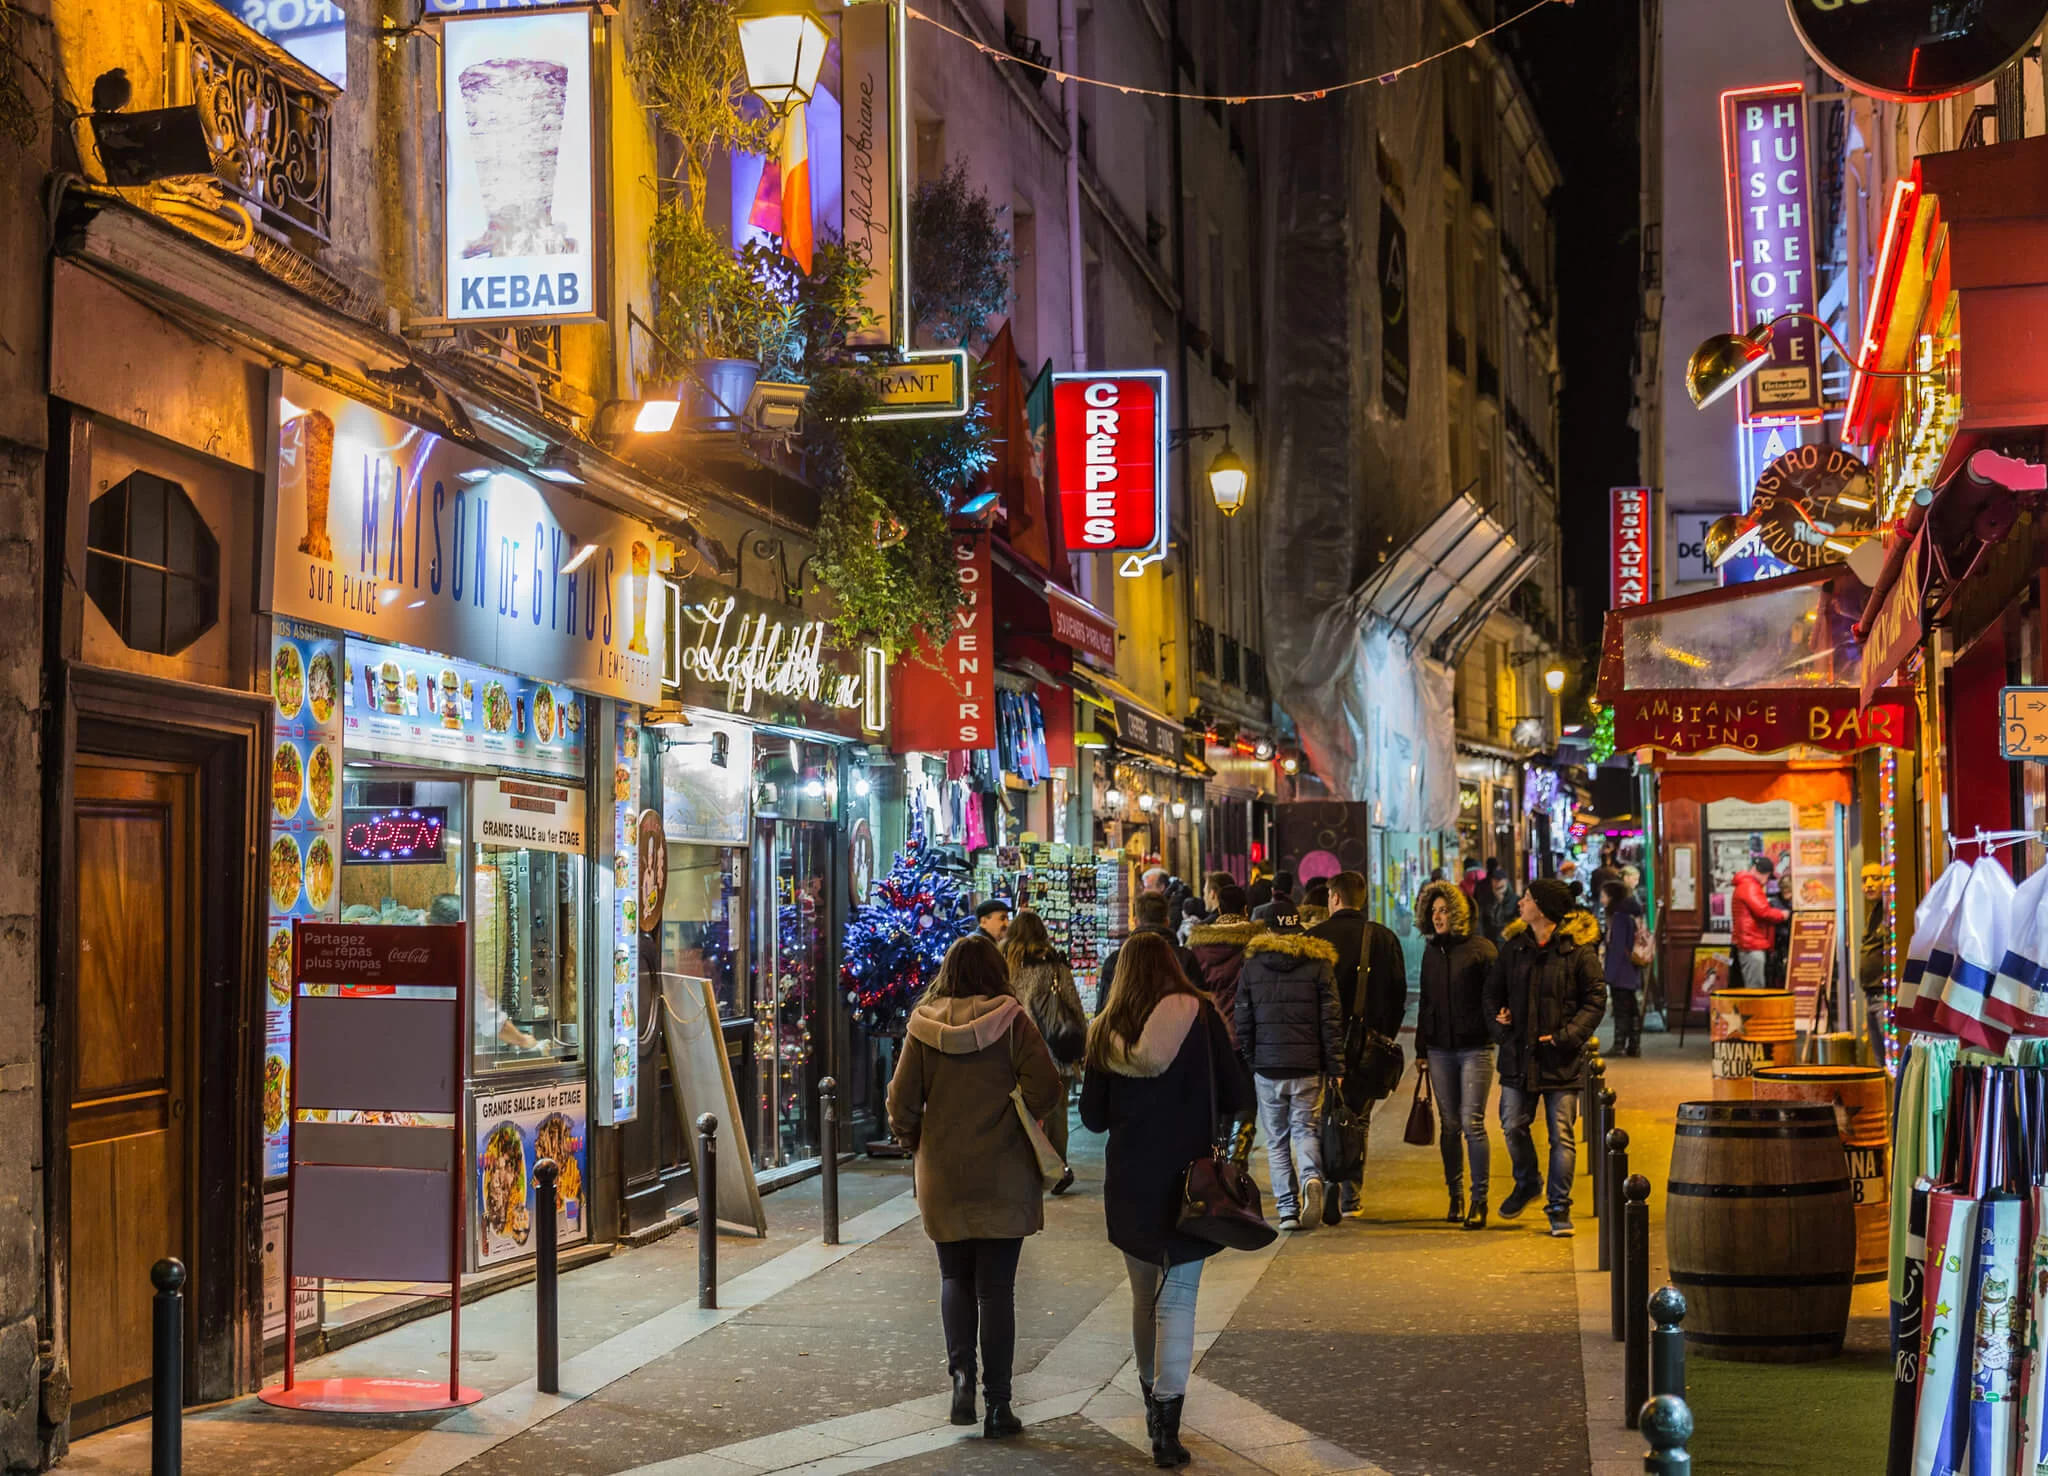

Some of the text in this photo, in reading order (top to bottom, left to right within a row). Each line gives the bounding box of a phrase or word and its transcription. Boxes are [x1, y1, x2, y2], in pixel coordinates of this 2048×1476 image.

[1746, 107, 1776, 297] BISTRO
[1773, 103, 1804, 361] HUCHETTE
[461, 272, 579, 310] KEBAB
[1756, 308, 1774, 325] DE
[1083, 382, 1119, 544] CRÊPES
[1753, 445, 1818, 510] BISTRO
[1828, 451, 1859, 480] DE
[1800, 496, 1831, 519] 27
[361, 454, 613, 645] MAISON DE GYROS
[1619, 490, 1643, 608] RESTAURAN
[309, 564, 377, 615] SUR PLACE
[1636, 700, 1777, 724] AMBIANCE
[2007, 694, 2024, 720] 1
[1655, 725, 1759, 749] LATINO
[1809, 706, 1892, 741] BAR
[2008, 724, 2031, 753] 2
[347, 822, 440, 851] OPEN
[483, 821, 580, 846] GRANDE SALLE au 1er ETAGE
[304, 932, 366, 949] Partagez
[305, 956, 382, 972] plus sympas
[1714, 1043, 1765, 1061] HAVANA
[1722, 1060, 1753, 1077] CLUB
[483, 1090, 581, 1118] GRANDE SALLE au 1er ETAGE
